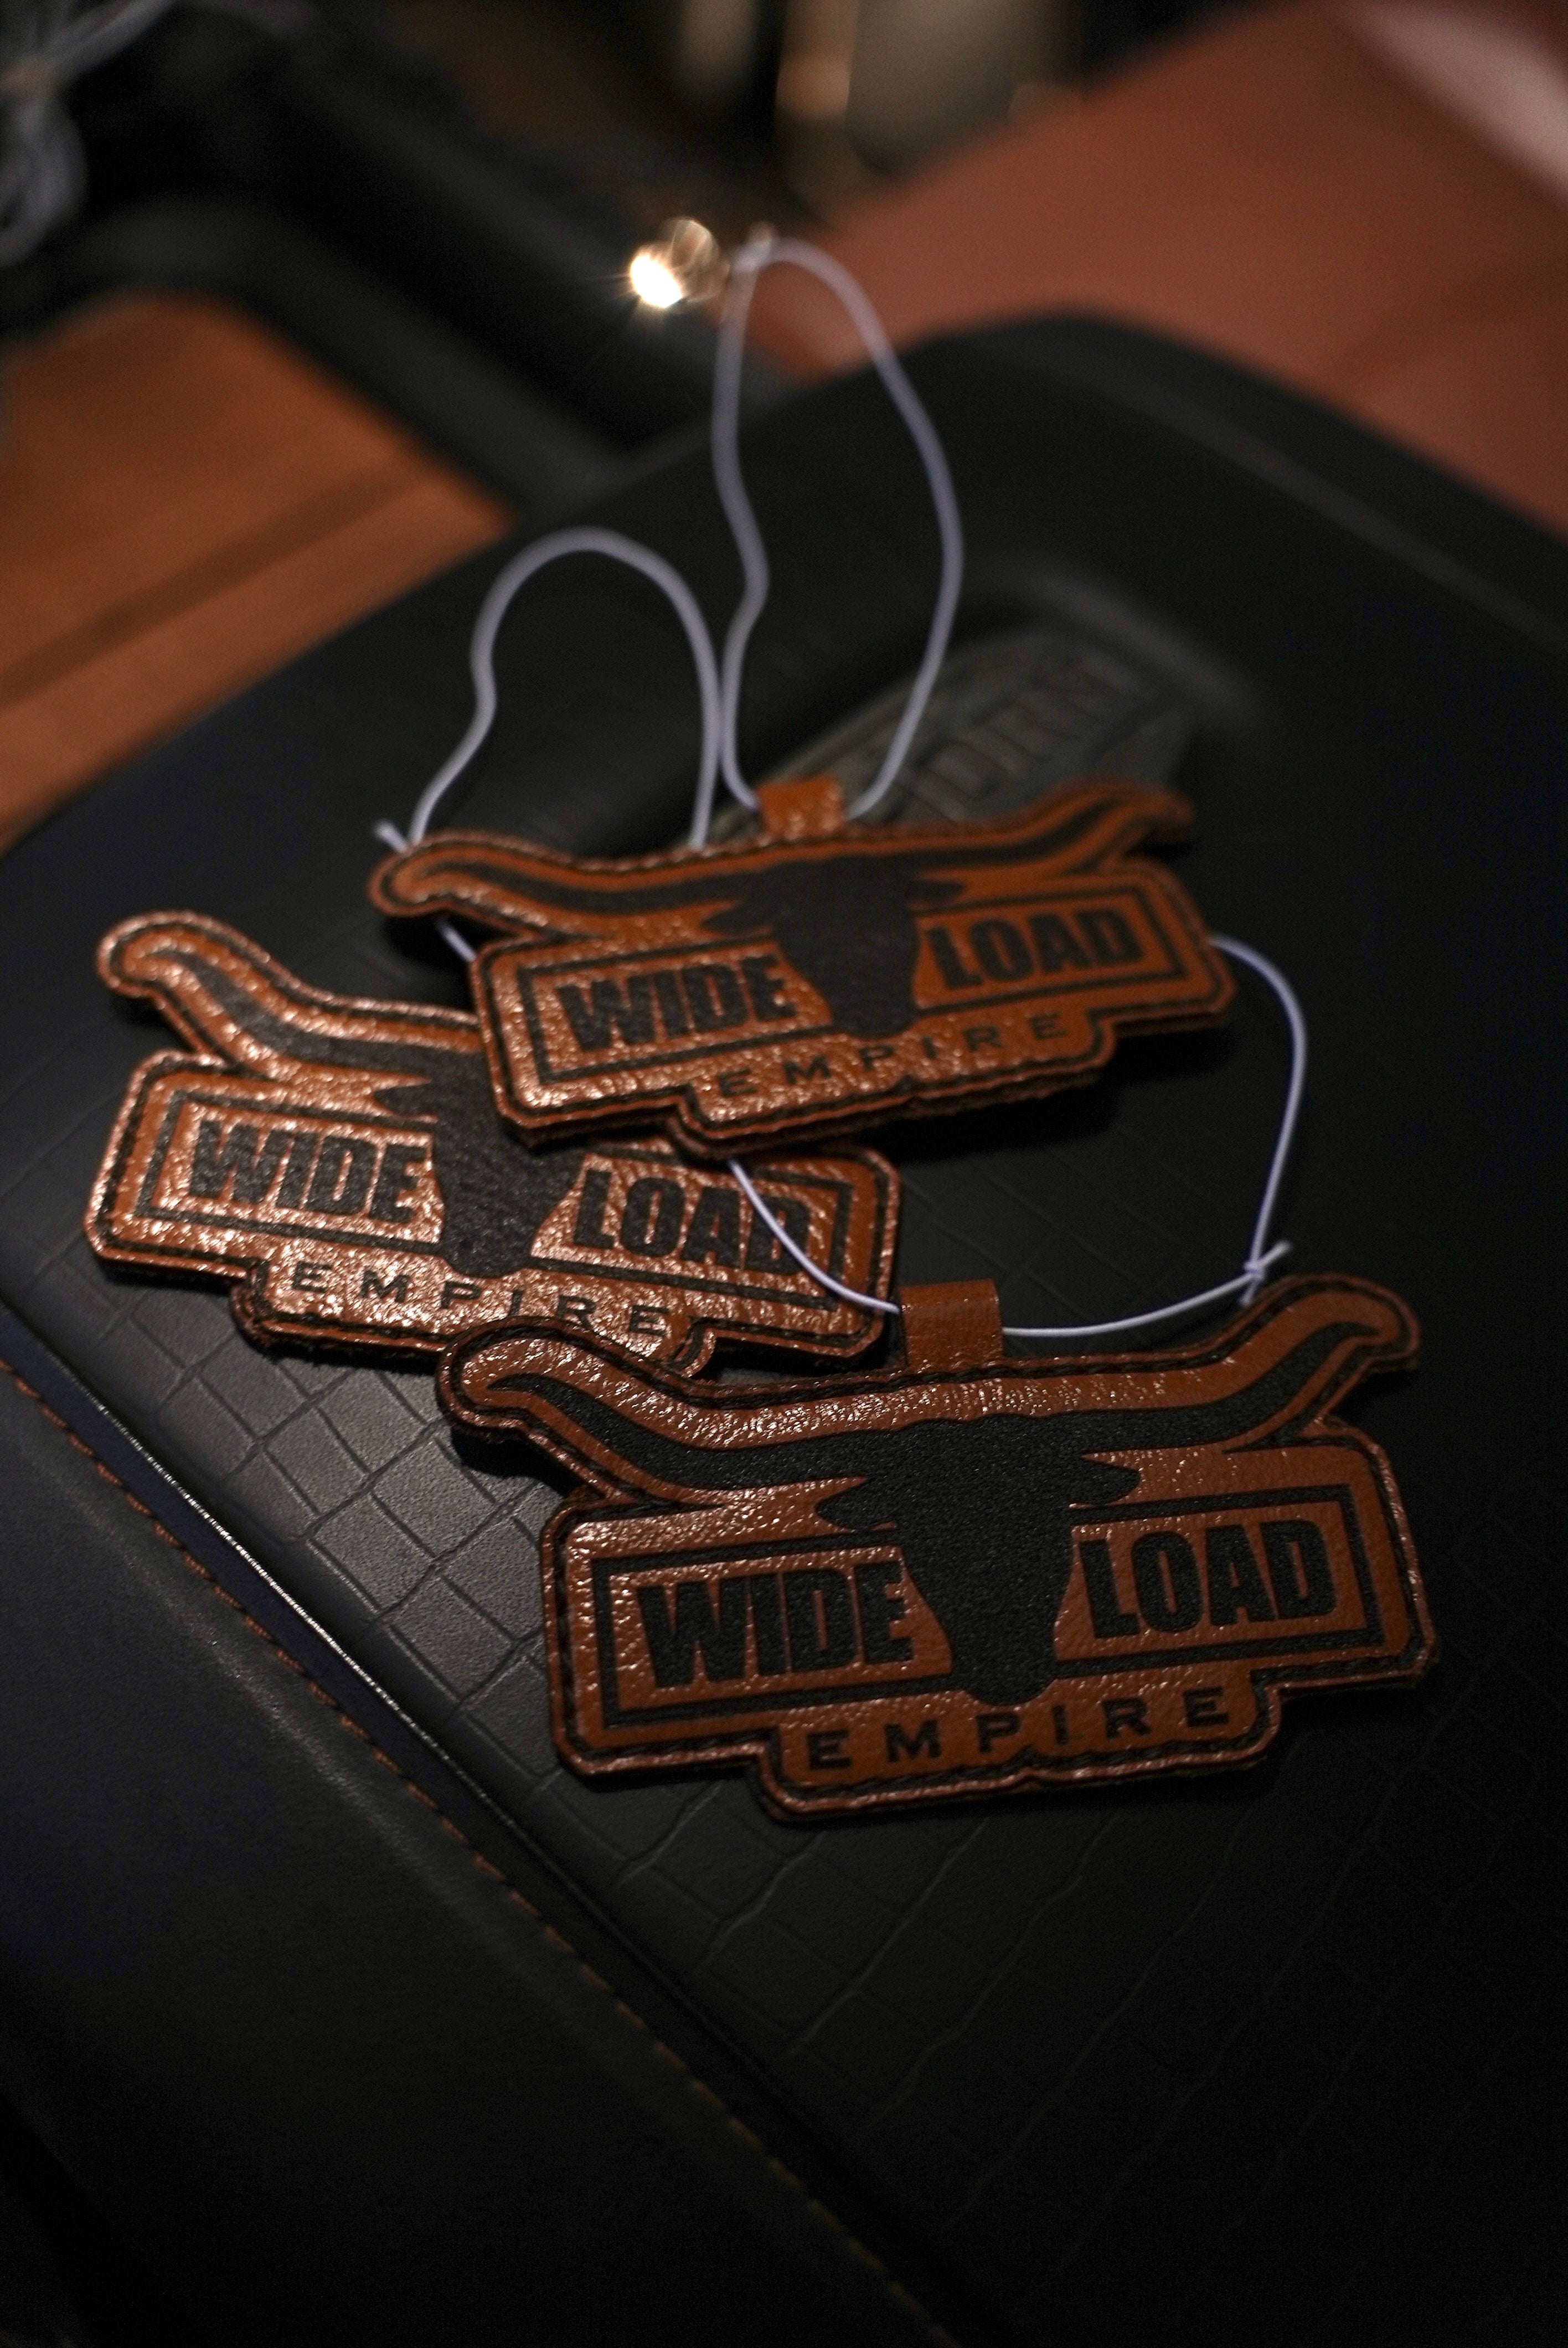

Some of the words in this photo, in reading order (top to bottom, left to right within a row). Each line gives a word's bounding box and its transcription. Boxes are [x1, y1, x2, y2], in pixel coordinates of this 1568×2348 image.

[558, 955, 797, 1052] WIDE
[926, 910, 1144, 988] LOAD
[715, 1015, 1070, 1095] EMPIRE
[188, 1119, 429, 1224] WIDE
[575, 1168, 808, 1275] LOAD
[295, 1263, 672, 1336] EMPIRE
[638, 1562, 912, 1687] WIDE
[1080, 1520, 1335, 1638] LOAD
[809, 1688, 1230, 1770] EMPIRE
